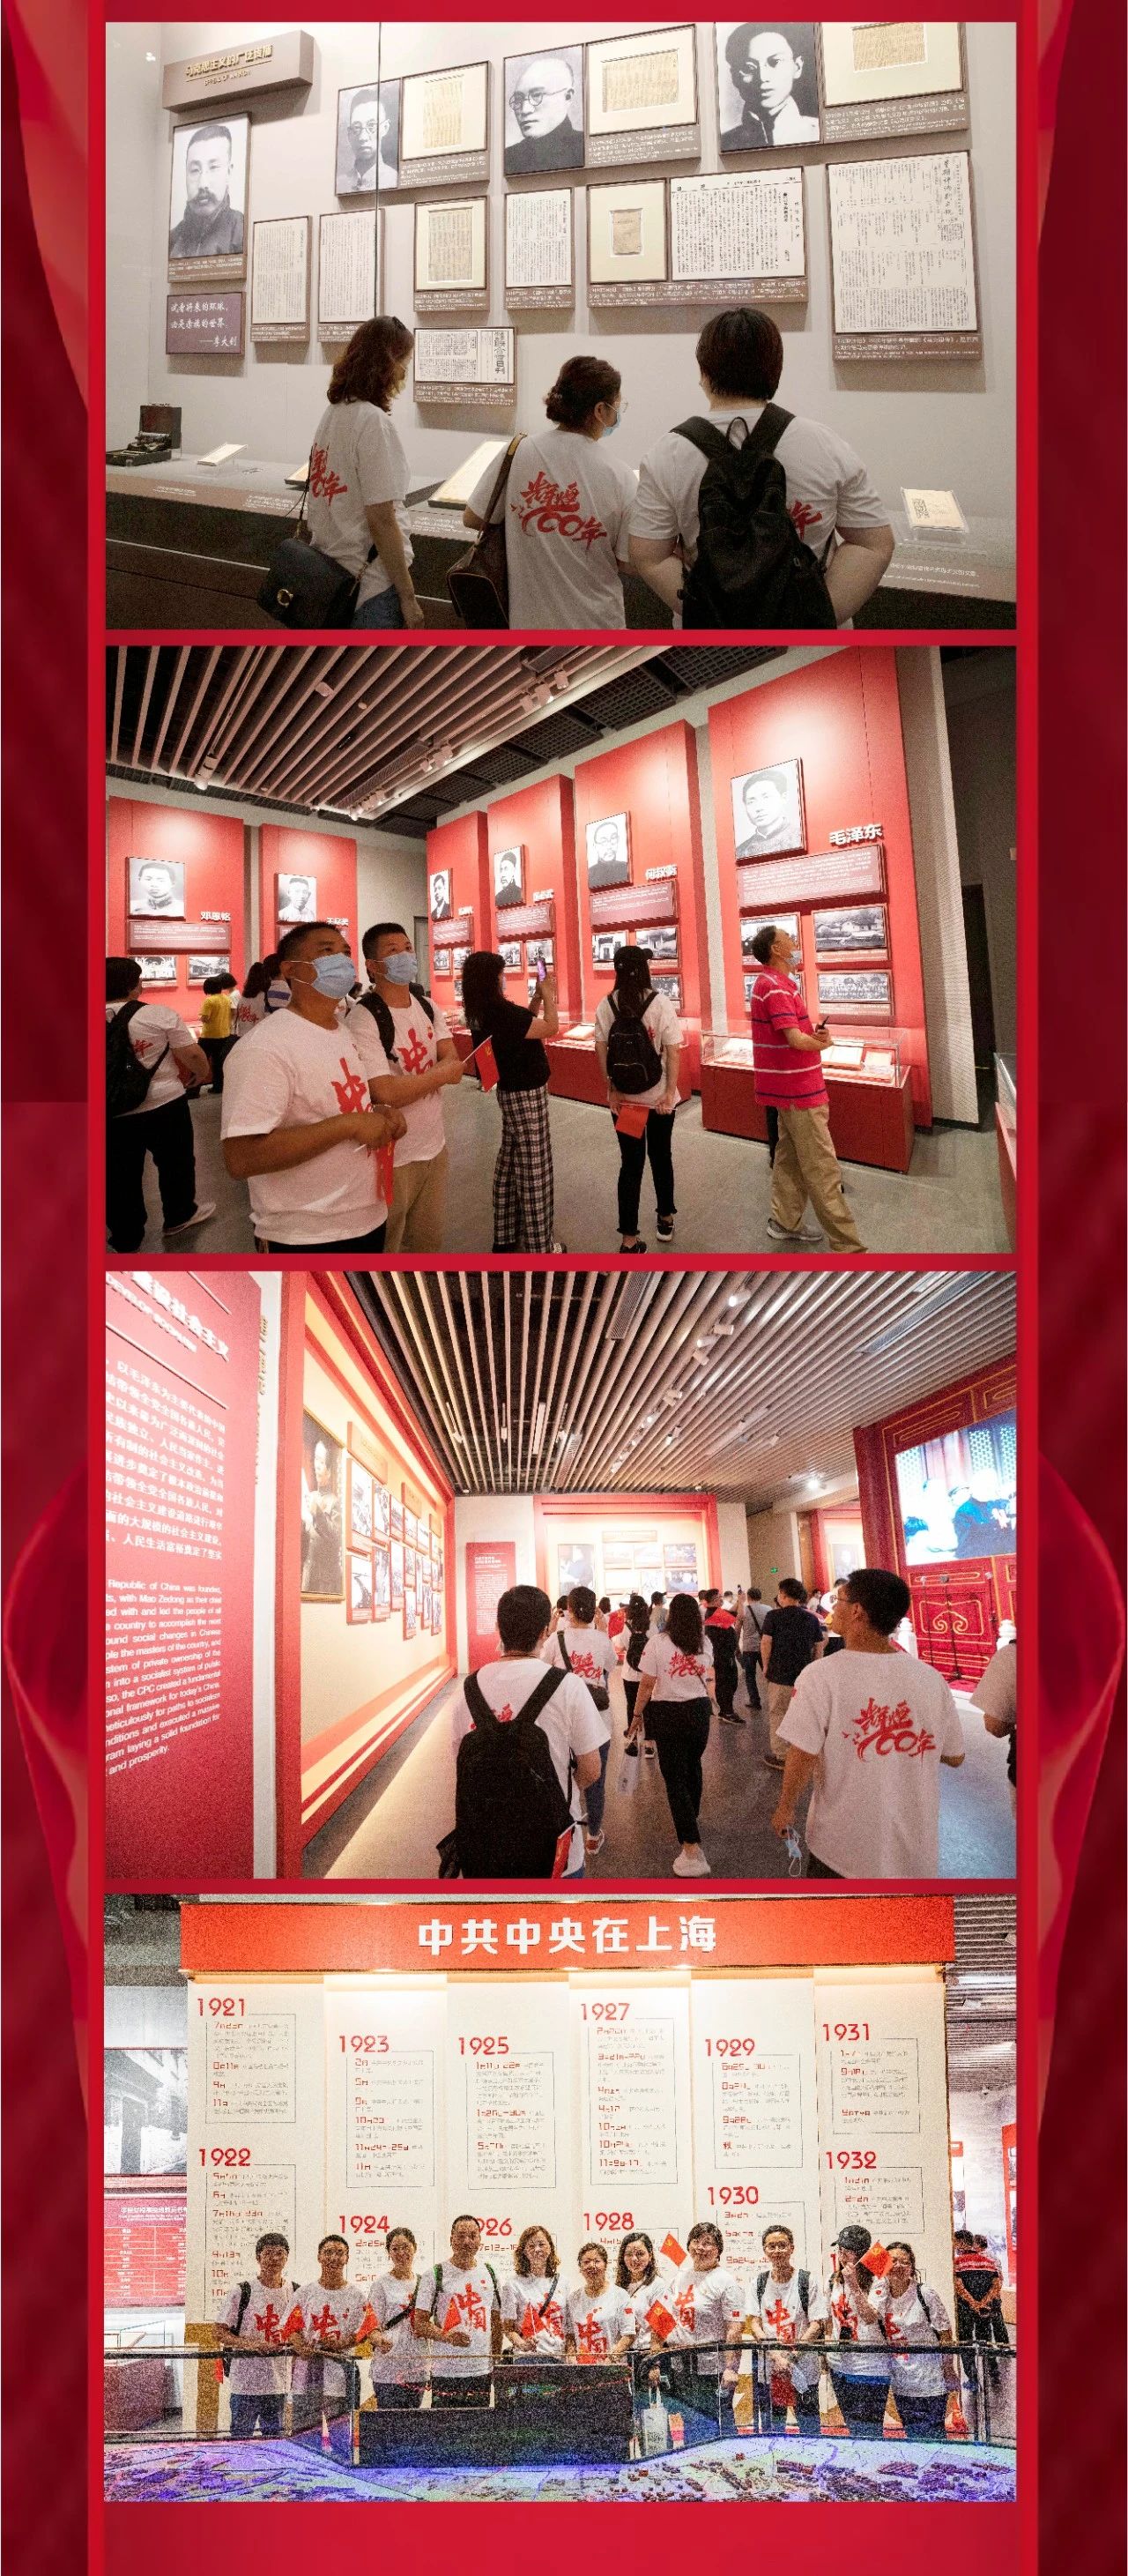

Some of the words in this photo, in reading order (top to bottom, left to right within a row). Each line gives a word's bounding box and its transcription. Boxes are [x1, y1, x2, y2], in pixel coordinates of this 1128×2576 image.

[828, 823, 884, 847] 毛泽东
[108, 1580, 145, 1590] Republic
[159, 1595, 184, 1604] Zedong
[115, 1622, 145, 1631] country
[132, 1634, 155, 1642] social
[121, 1649, 134, 1657] the
[136, 1646, 166, 1656] masters
[131, 1661, 140, 1670] of
[144, 1658, 168, 1669] private
[171, 1652, 203, 1664] ownership
[114, 1676, 130, 1686] into
[141, 1670, 171, 1681] socialist
[174, 1664, 196, 1676] system
[204, 1660, 220, 1670] public
[122, 1690, 135, 1700] the
[137, 1685, 155, 1696] CPC
[156, 1679, 181, 1692] created
[126, 1694, 167, 1712] framework
[167, 1702, 186, 1715] paths
[195, 1693, 220, 1705] socialism
[142, 1723, 157, 1734] and
[160, 1711, 189, 1728] executed
[197, 1703, 220, 1716] massive
[127, 1738, 152, 1753] laying
[161, 1728, 178, 1740] solid
[180, 1717, 212, 1733] foundation
[108, 1761, 127, 1775] and
[129, 1746, 169, 1768] prosperity.
[418, 1916, 716, 1956] 中共中央在上海
[197, 1998, 247, 2017] 1921
[580, 2002, 630, 2021] 1927
[822, 2023, 871, 2042] 1931
[338, 2035, 390, 2053] 1923
[457, 2035, 509, 2056] 1925
[705, 2038, 756, 2058] 1929
[198, 2148, 251, 2168] 1922
[825, 2151, 877, 2170] 1932
[708, 2185, 759, 2205] 1930
[339, 2215, 390, 2234] 1924
[477, 2218, 512, 2236] 926
[583, 2213, 634, 2231] 1928
[455, 2283, 486, 2332] 中国
